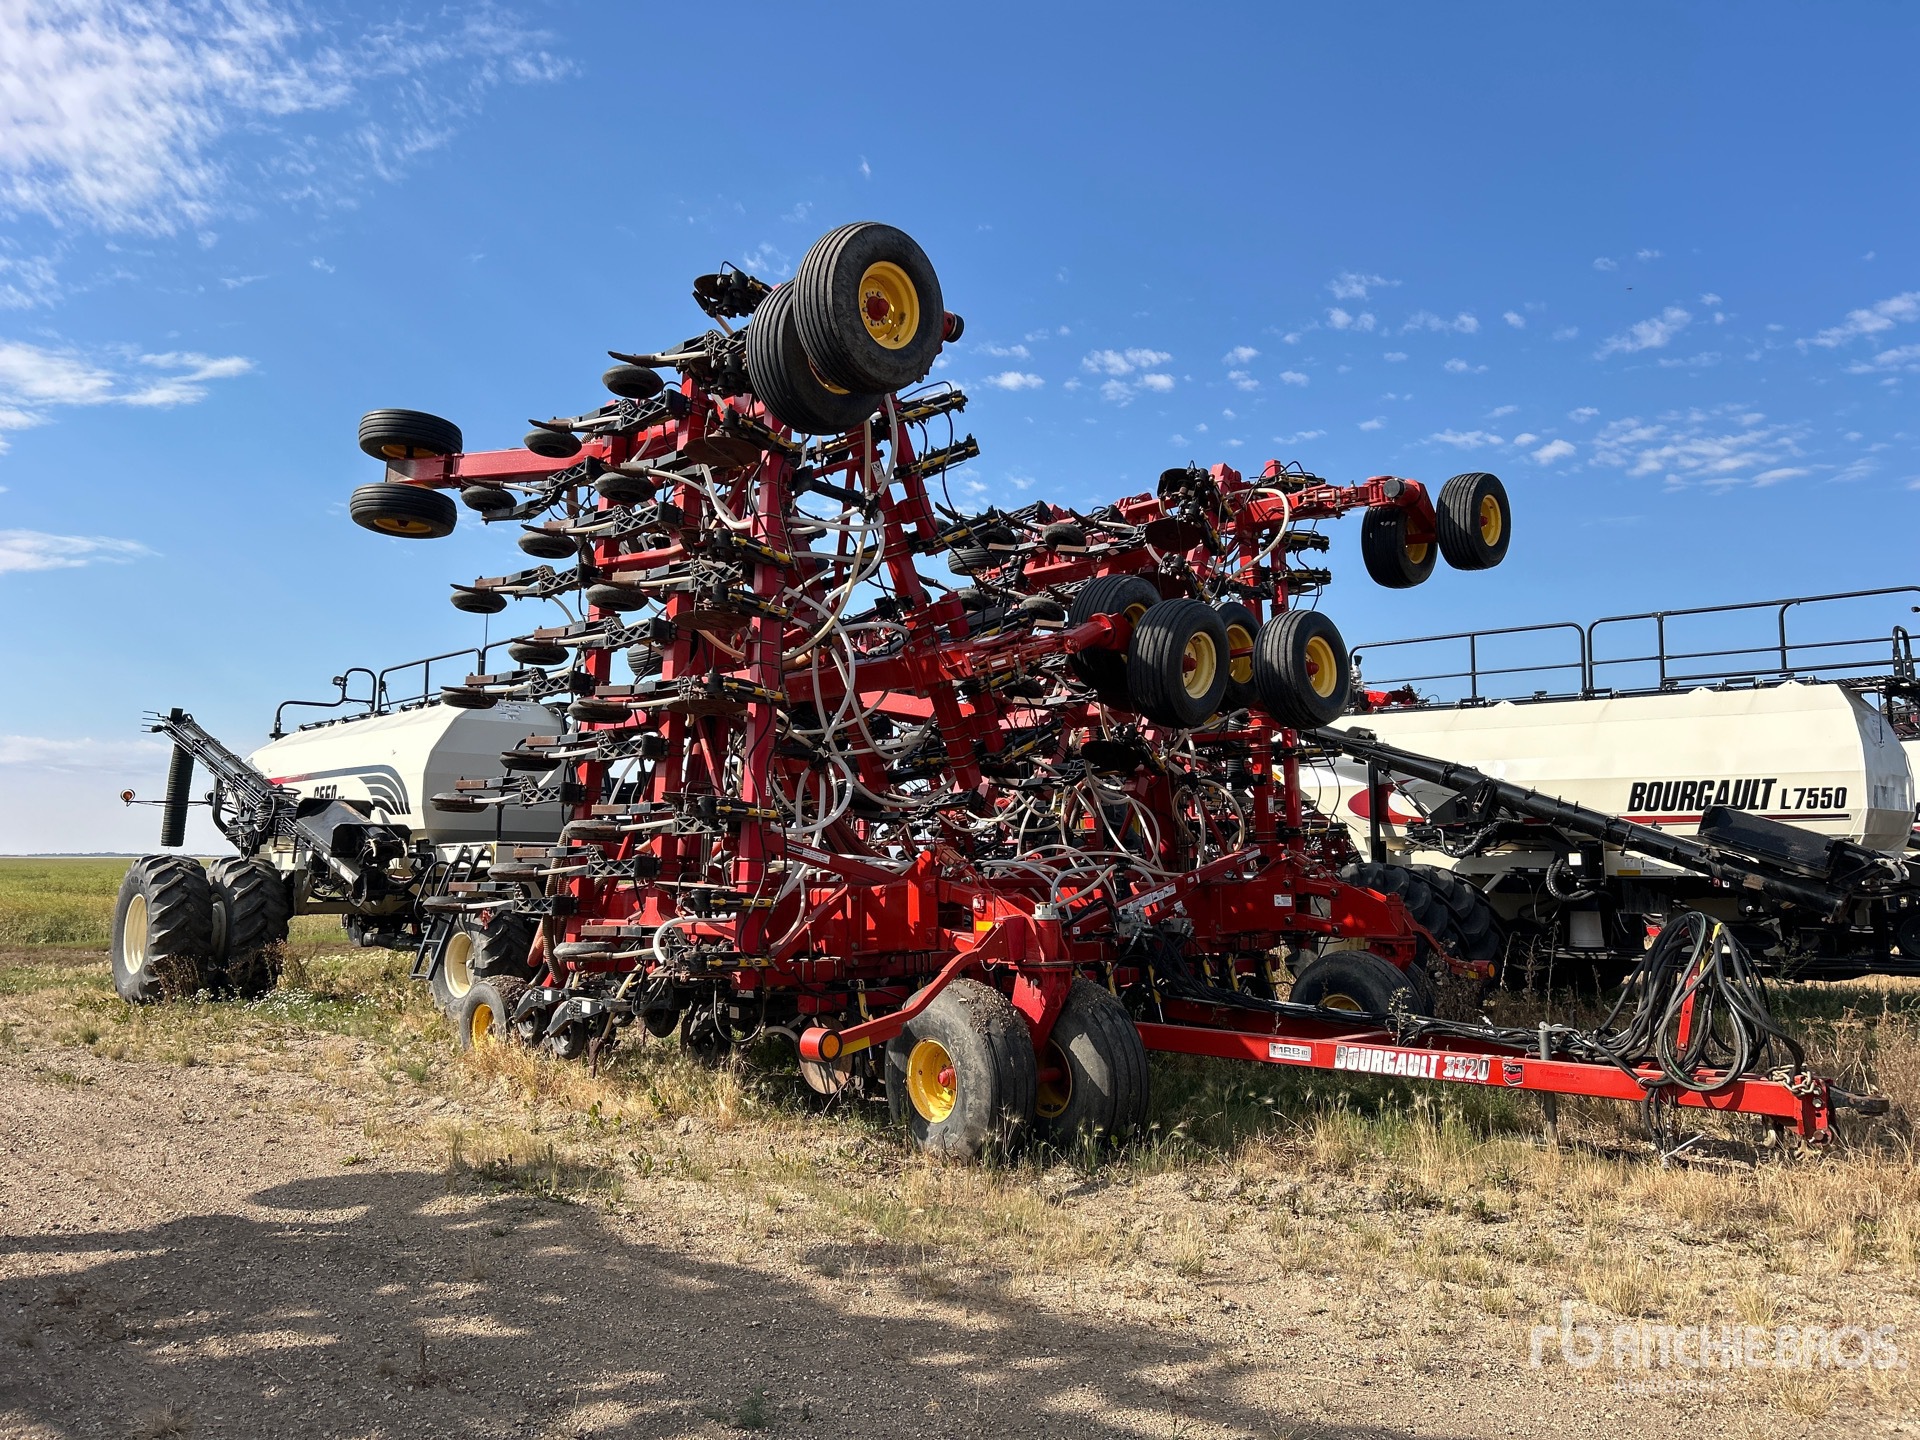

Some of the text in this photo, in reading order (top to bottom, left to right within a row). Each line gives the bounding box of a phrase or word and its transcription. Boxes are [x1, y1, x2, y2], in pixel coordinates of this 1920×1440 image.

[1627, 778, 1777, 812] BOURGAULT
[1334, 1045, 1490, 1081] BOURGAULT 3320
